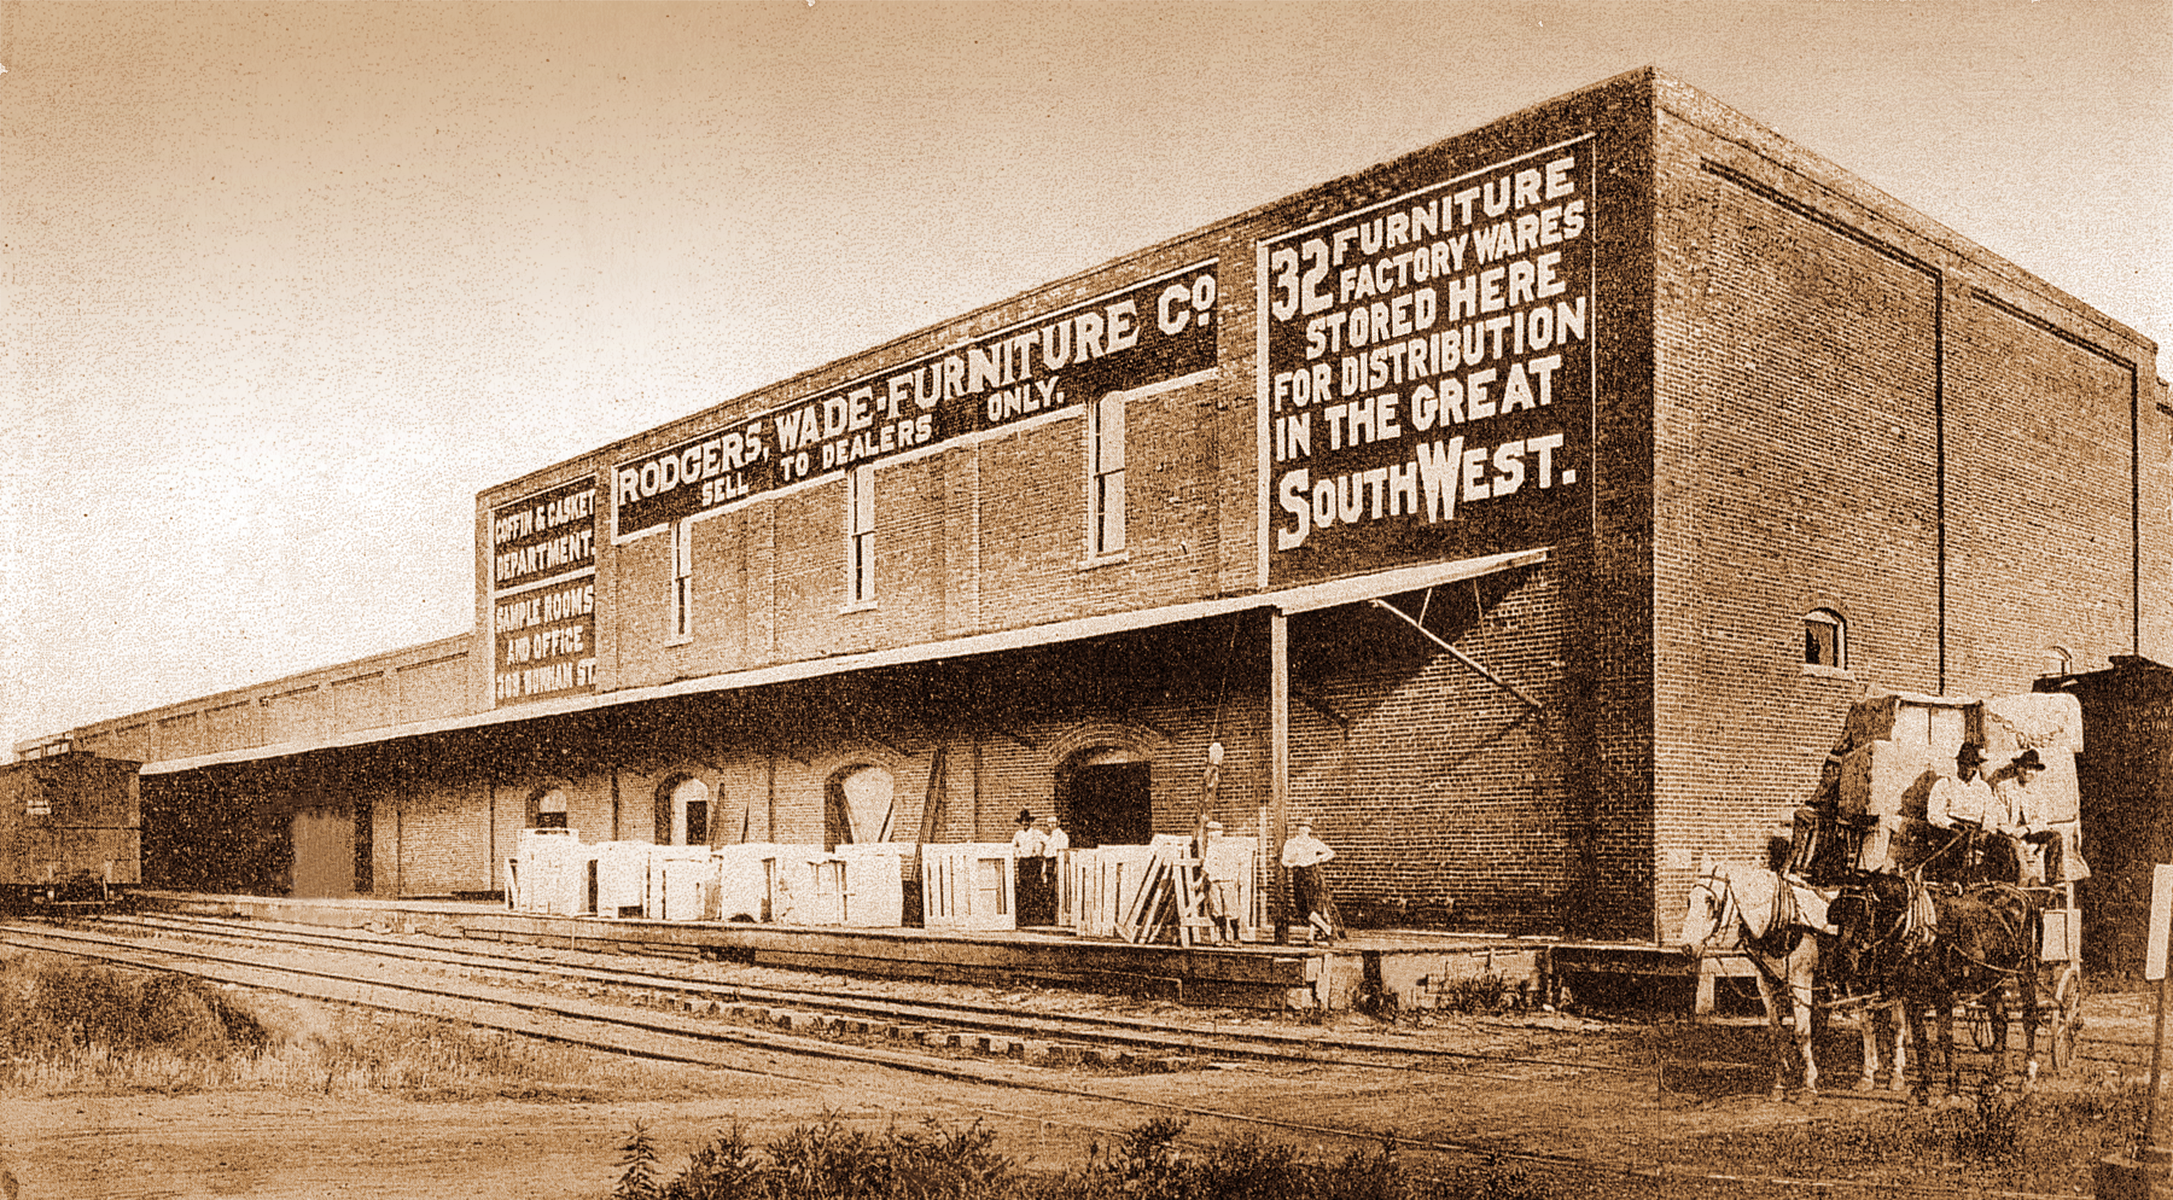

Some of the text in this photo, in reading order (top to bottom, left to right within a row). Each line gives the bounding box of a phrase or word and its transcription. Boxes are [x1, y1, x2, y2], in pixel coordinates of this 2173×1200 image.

[1271, 156, 1576, 322] 32 FURNITURE
[1339, 199, 1586, 304] FACTORY WARES
[1274, 296, 1587, 412] FOR DISTRIBUTION
[1305, 251, 1567, 360] STORED HERE
[702, 376, 1065, 507] SELL TO DEALERS ONLY.
[1275, 355, 1562, 462] IN THE GREAT
[618, 420, 770, 506] RODGERS,
[496, 489, 597, 544] COFFIN & CASKET
[496, 530, 597, 581] DEPARTMENT.
[496, 585, 594, 634] SAMPLE ROOMS
[507, 626, 584, 665] AND OFFICE
